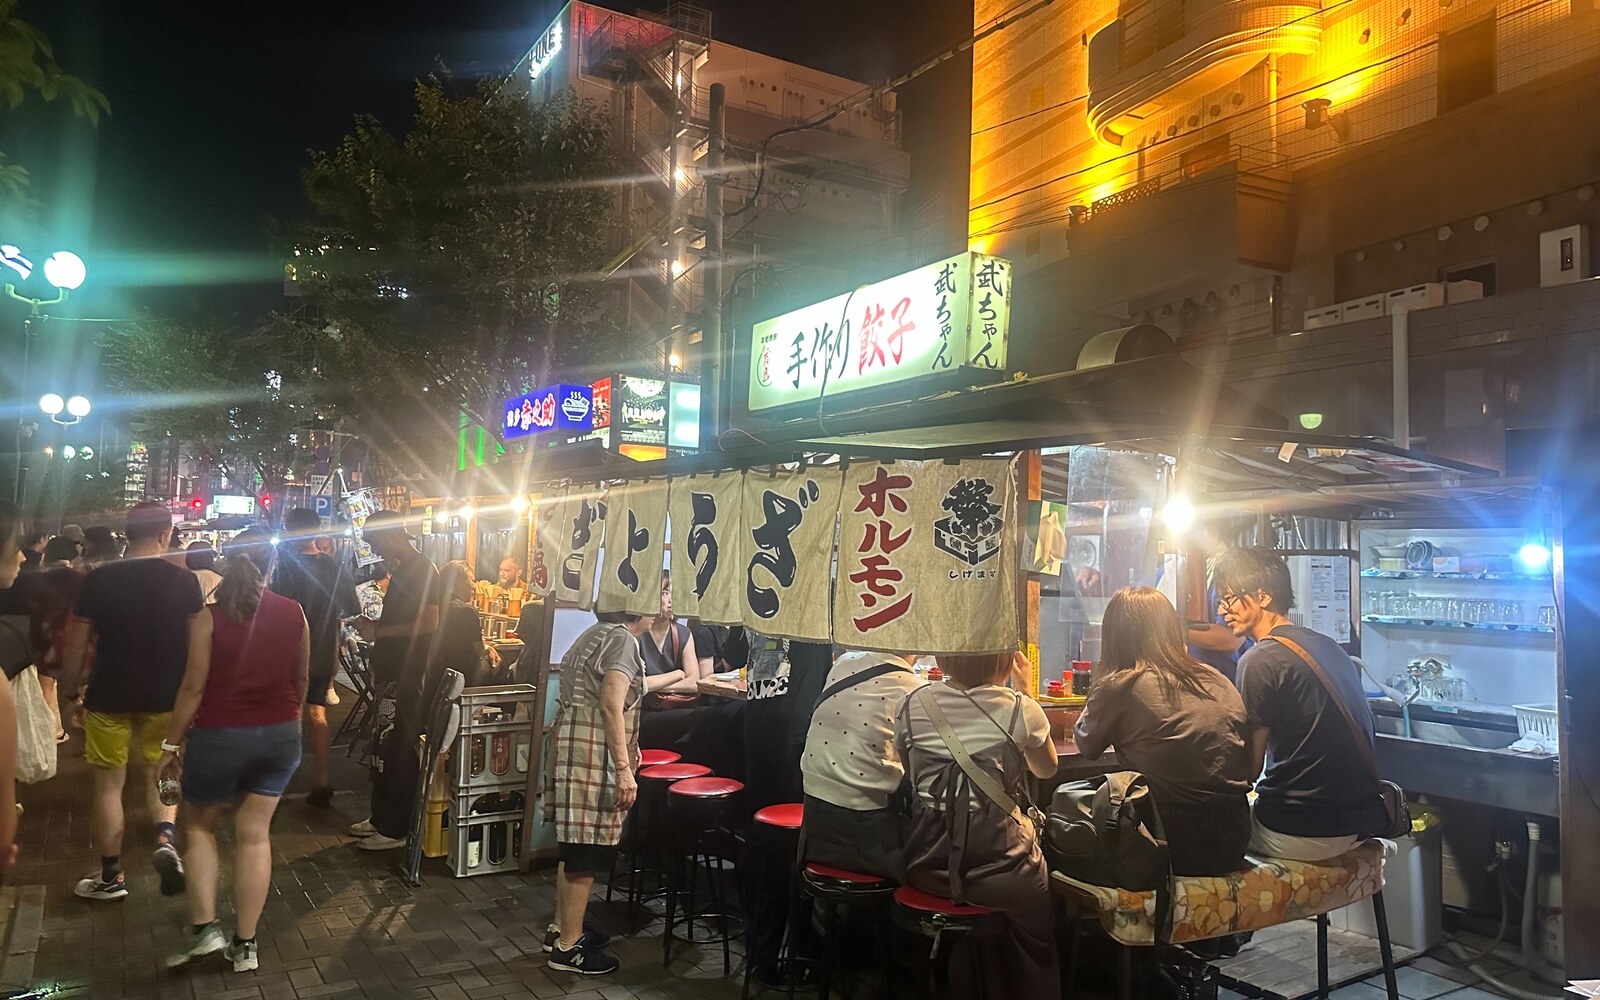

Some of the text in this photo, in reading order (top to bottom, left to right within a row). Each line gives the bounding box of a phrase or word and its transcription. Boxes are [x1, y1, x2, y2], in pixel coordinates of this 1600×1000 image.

[932, 262, 958, 370] 武ちゃん
[973, 260, 1004, 370] 武ちゃん
[316, 498, 328, 515] P
[850, 467, 913, 633] ホルモン
